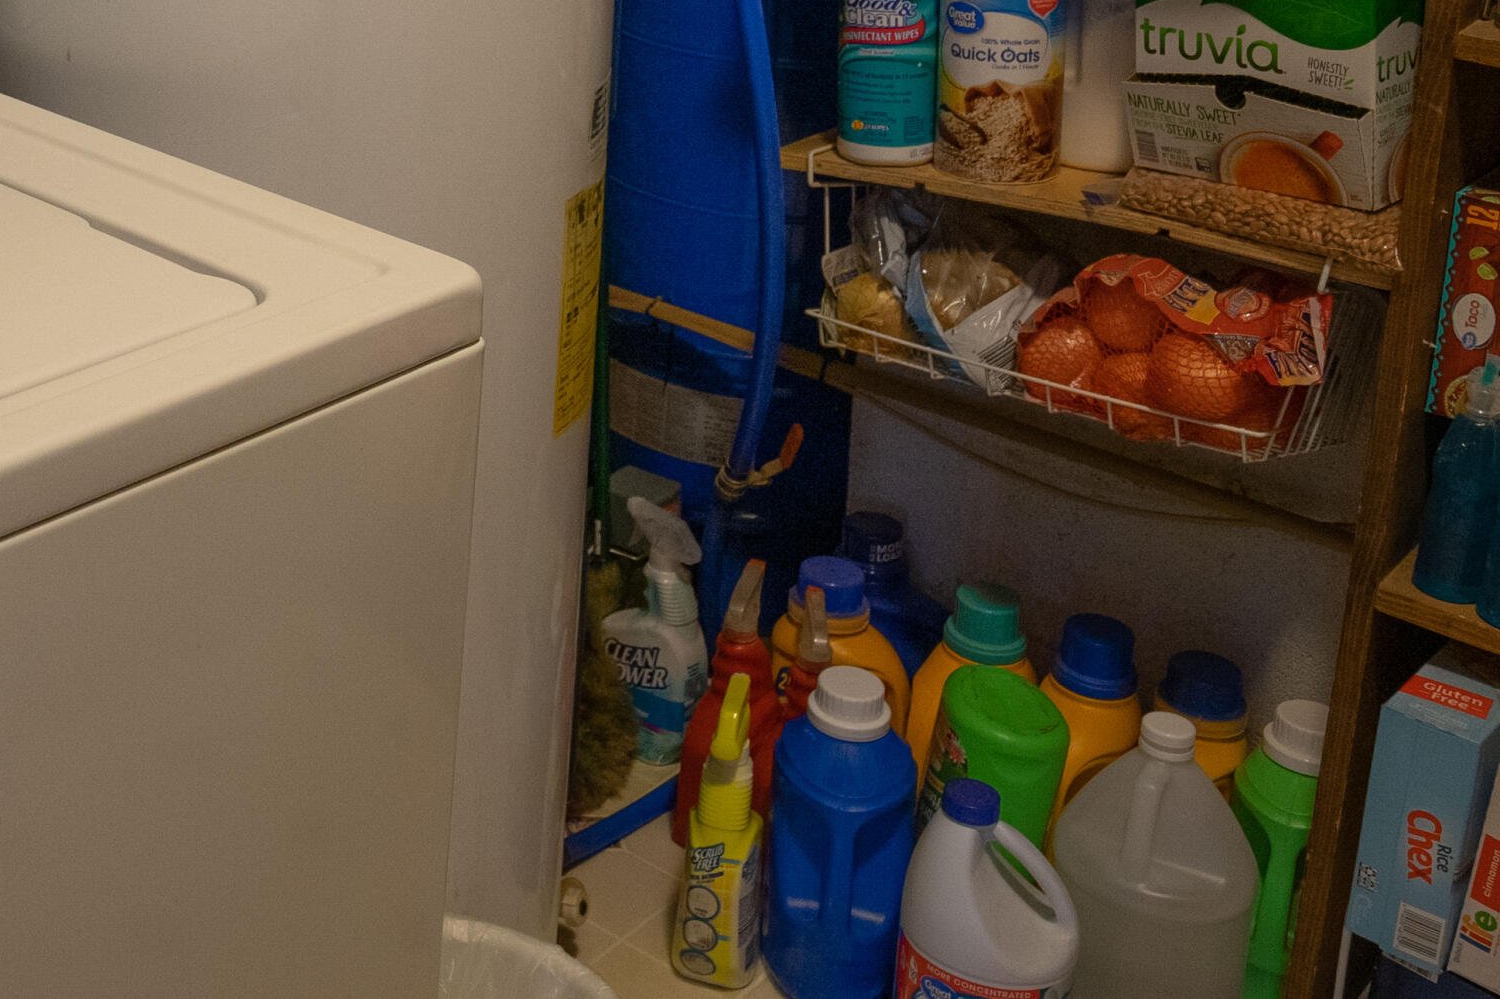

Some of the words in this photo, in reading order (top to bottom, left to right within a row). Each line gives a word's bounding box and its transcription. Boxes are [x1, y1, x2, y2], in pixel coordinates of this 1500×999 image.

[844, 8, 908, 27] Clean
[948, 6, 977, 21] Great
[893, 28, 920, 40] WIPES
[950, 42, 998, 63] Quick
[1000, 46, 1041, 63] Oats
[1376, 46, 1420, 82] truv
[1307, 56, 1350, 77] HONESTLY
[1307, 70, 1344, 90] SWEET!
[1127, 92, 1191, 118] NATURALLY
[1165, 122, 1198, 140] STEVIA
[1199, 130, 1225, 143] LEAF
[1465, 204, 1500, 231] 12
[1465, 300, 1481, 329] Taco
[604, 638, 659, 668] CLEAN
[618, 663, 668, 689] OWER
[1422, 681, 1484, 708] Gluten
[1429, 692, 1471, 711] Free
[692, 844, 725, 862] SCRUB
[1406, 809, 1443, 886] Chex
[1436, 843, 1452, 873] Rice
[695, 858, 721, 872] FREE
[1482, 849, 1500, 897] cinnamon
[1459, 910, 1498, 954] life
[925, 963, 951, 981] MORE
[953, 977, 1033, 999] CONCENTRATED
